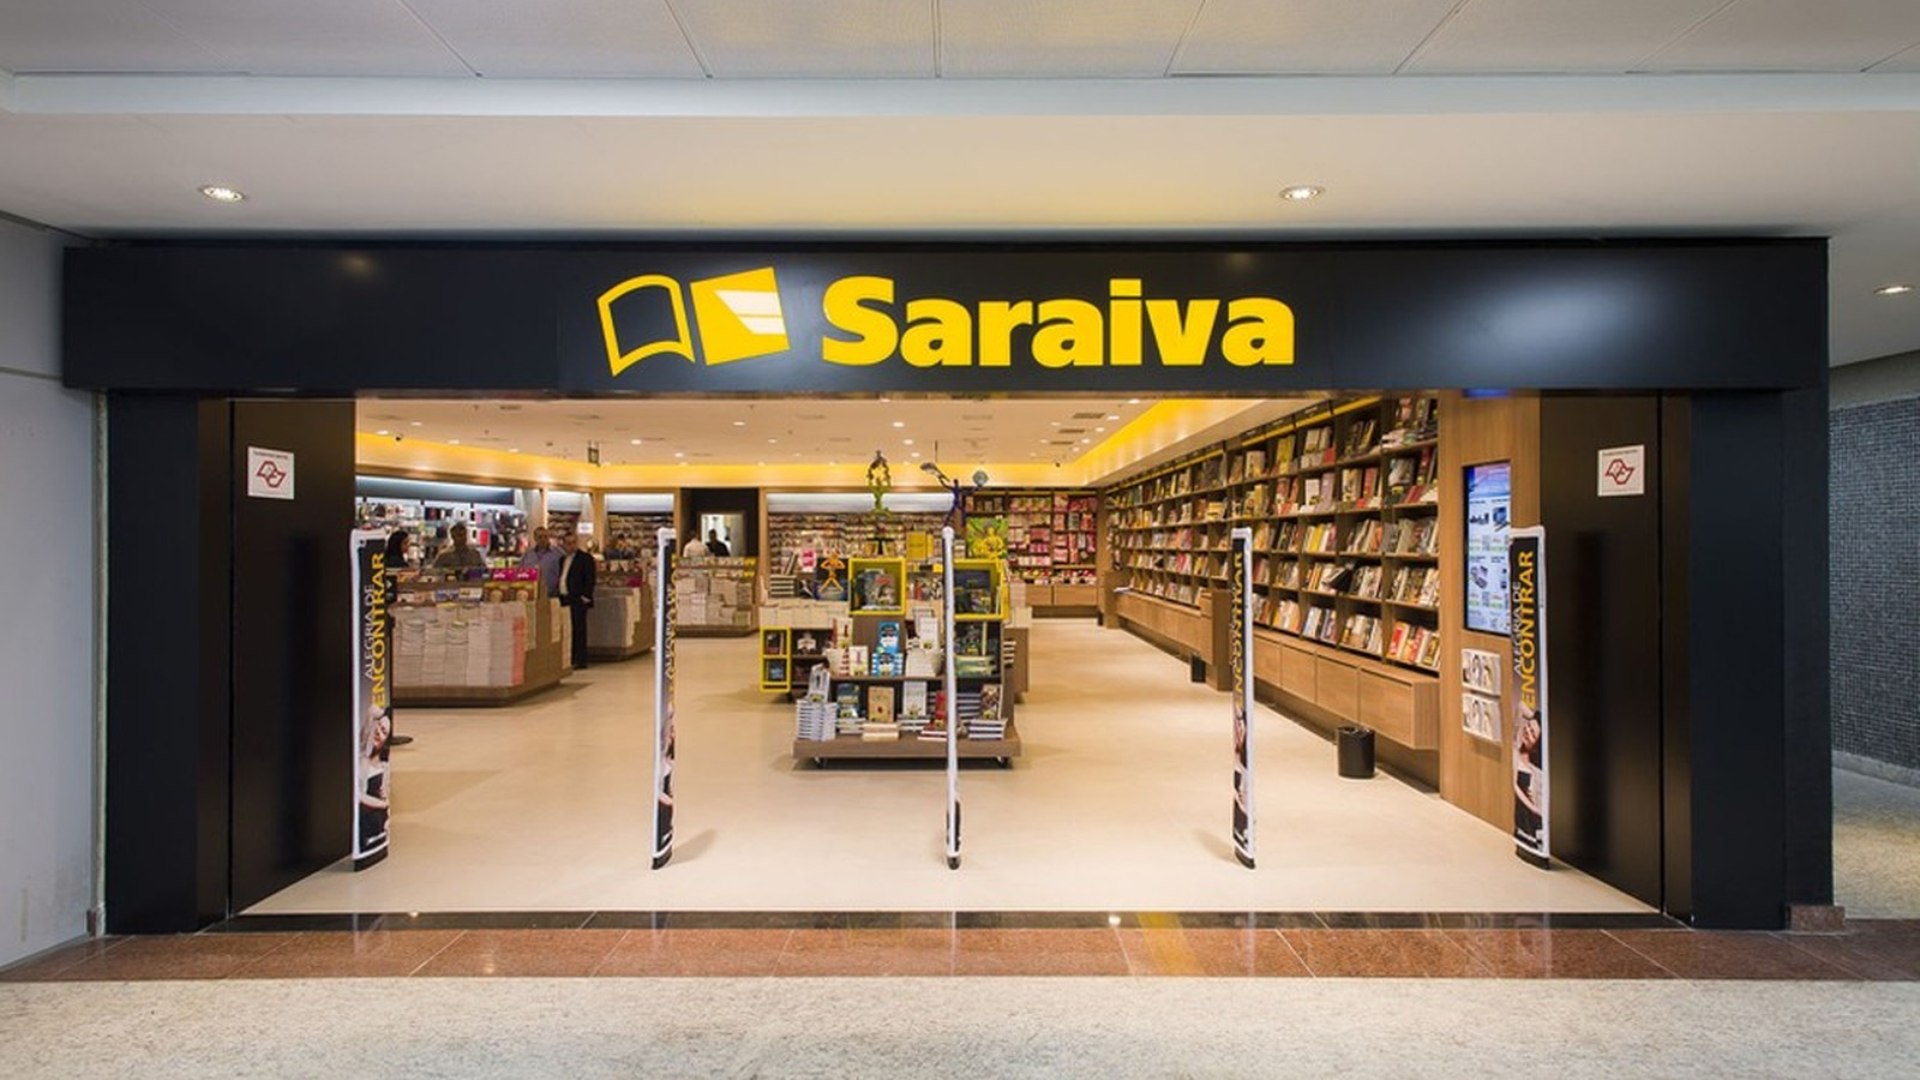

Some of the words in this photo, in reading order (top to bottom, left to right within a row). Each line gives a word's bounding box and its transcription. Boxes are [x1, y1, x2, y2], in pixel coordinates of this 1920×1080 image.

[822, 276, 1295, 368] Saraiva
[364, 585, 375, 605] DE
[372, 552, 385, 707] ENCONTRAR
[1513, 581, 1522, 604] DE
[364, 607, 375, 681] ALEGRIA
[1513, 606, 1523, 677] ALEGRIA
[1519, 551, 1536, 710] ENCONTRAR
